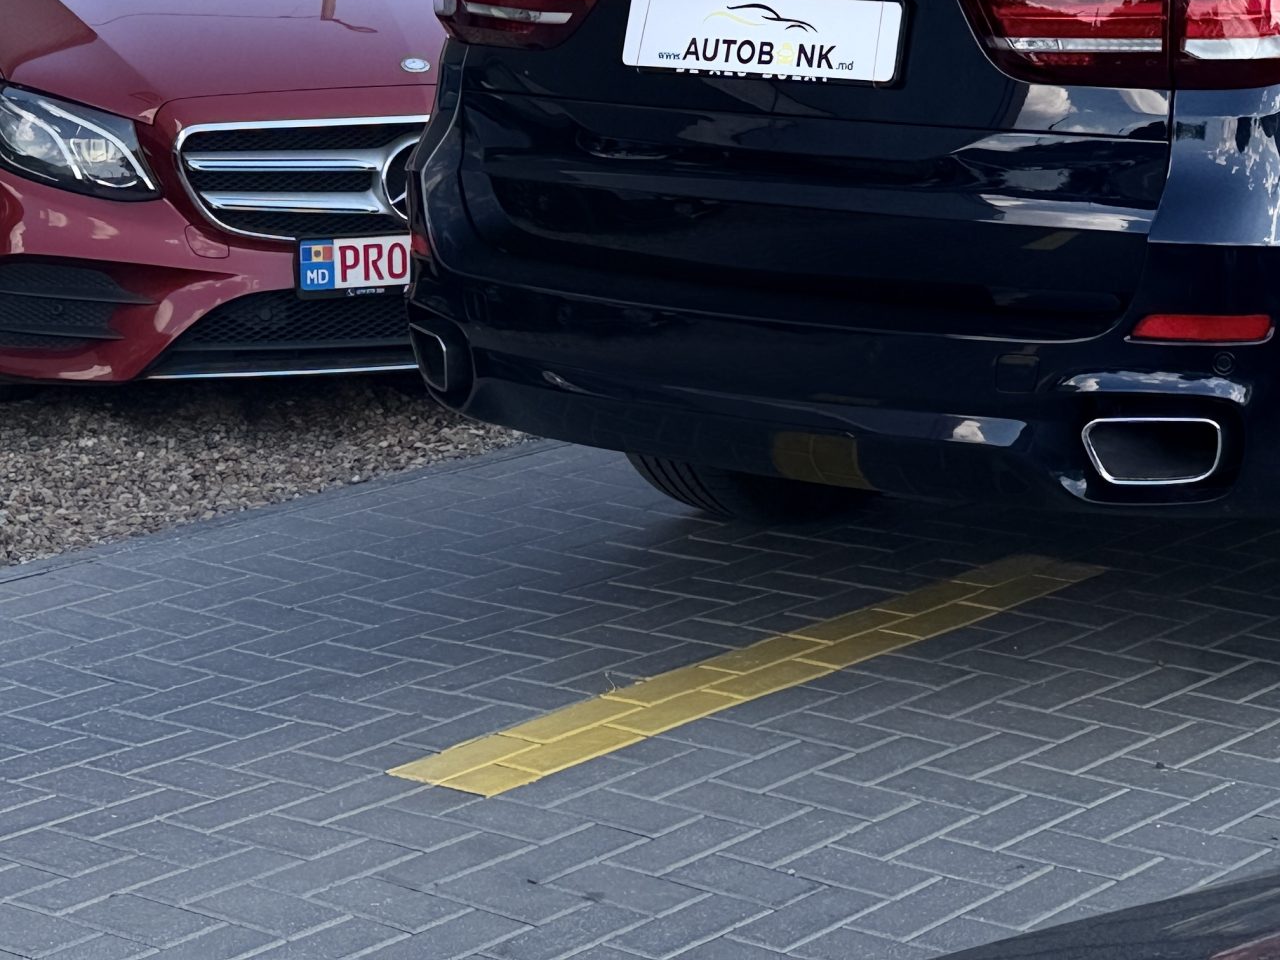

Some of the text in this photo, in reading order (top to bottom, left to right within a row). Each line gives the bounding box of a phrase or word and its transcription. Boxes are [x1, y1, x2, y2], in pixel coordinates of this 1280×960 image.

[682, 36, 837, 71] AUTOBNK
[306, 269, 329, 285] MD
[338, 242, 408, 283] PRO
